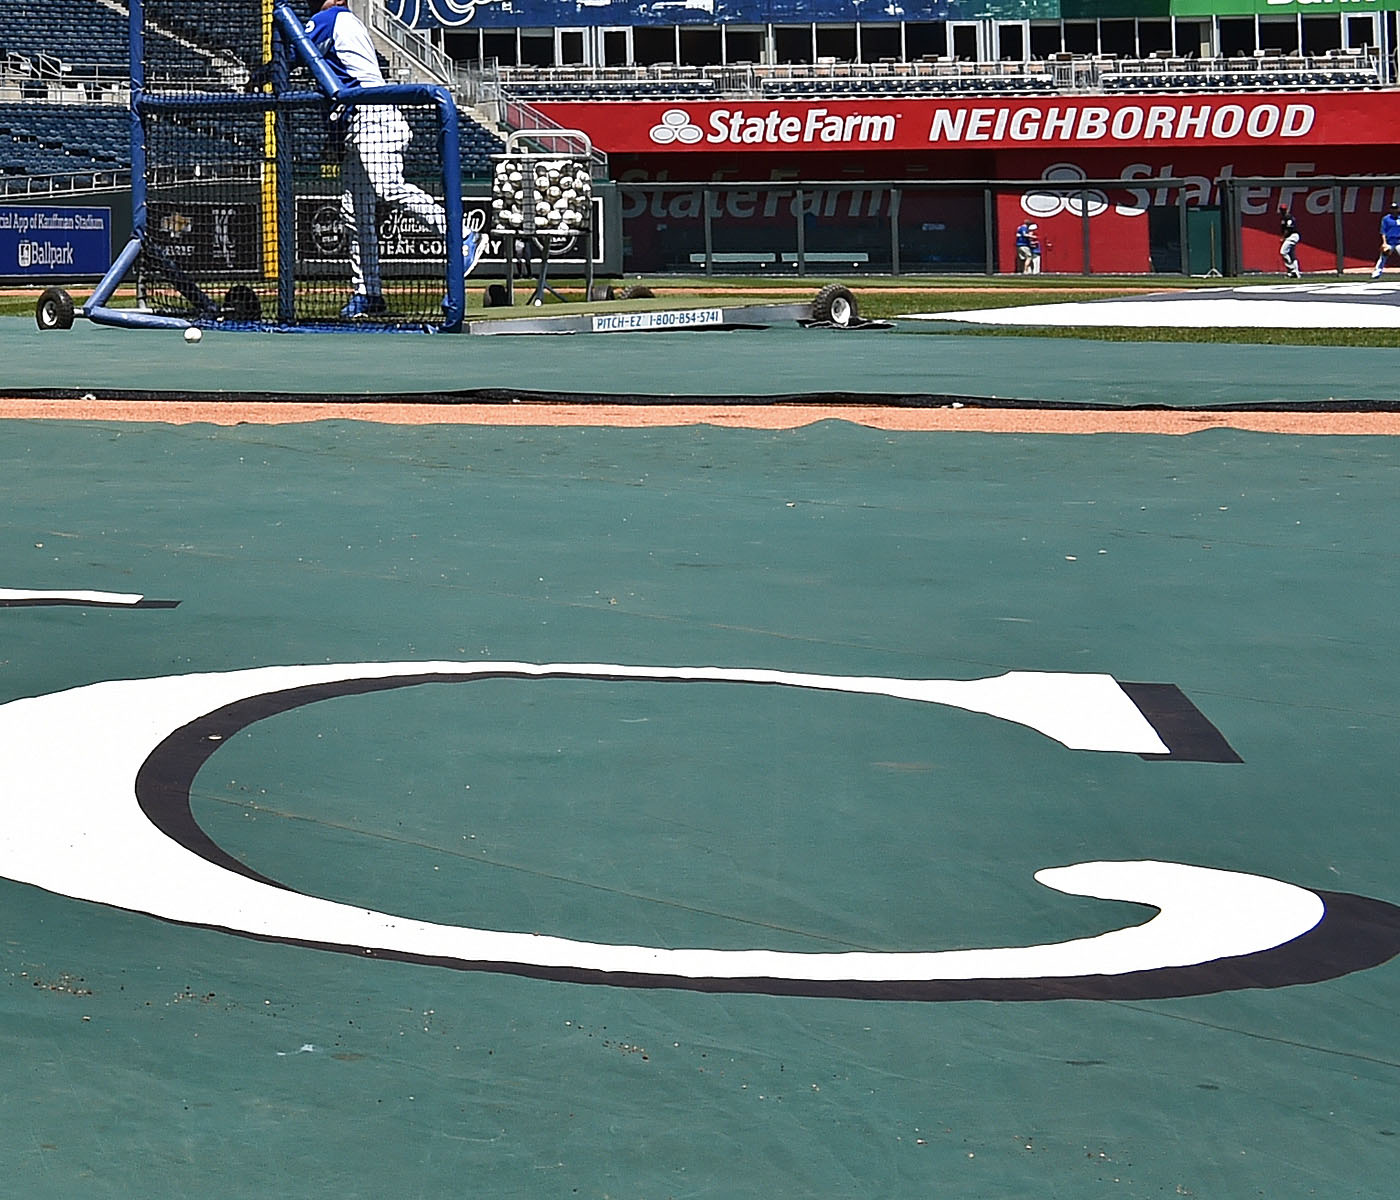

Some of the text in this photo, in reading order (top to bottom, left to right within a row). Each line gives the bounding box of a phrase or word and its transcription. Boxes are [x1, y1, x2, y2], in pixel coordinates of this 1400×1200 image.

[929, 104, 1316, 141] NEIGHBORHOOD
[13, 213, 29, 233] App
[30, 213, 37, 229] of
[75, 215, 104, 230] Stadium
[31, 241, 73, 269] Ballpark
[597, 311, 719, 329] PITCH-EZ 1-800-854-5741
